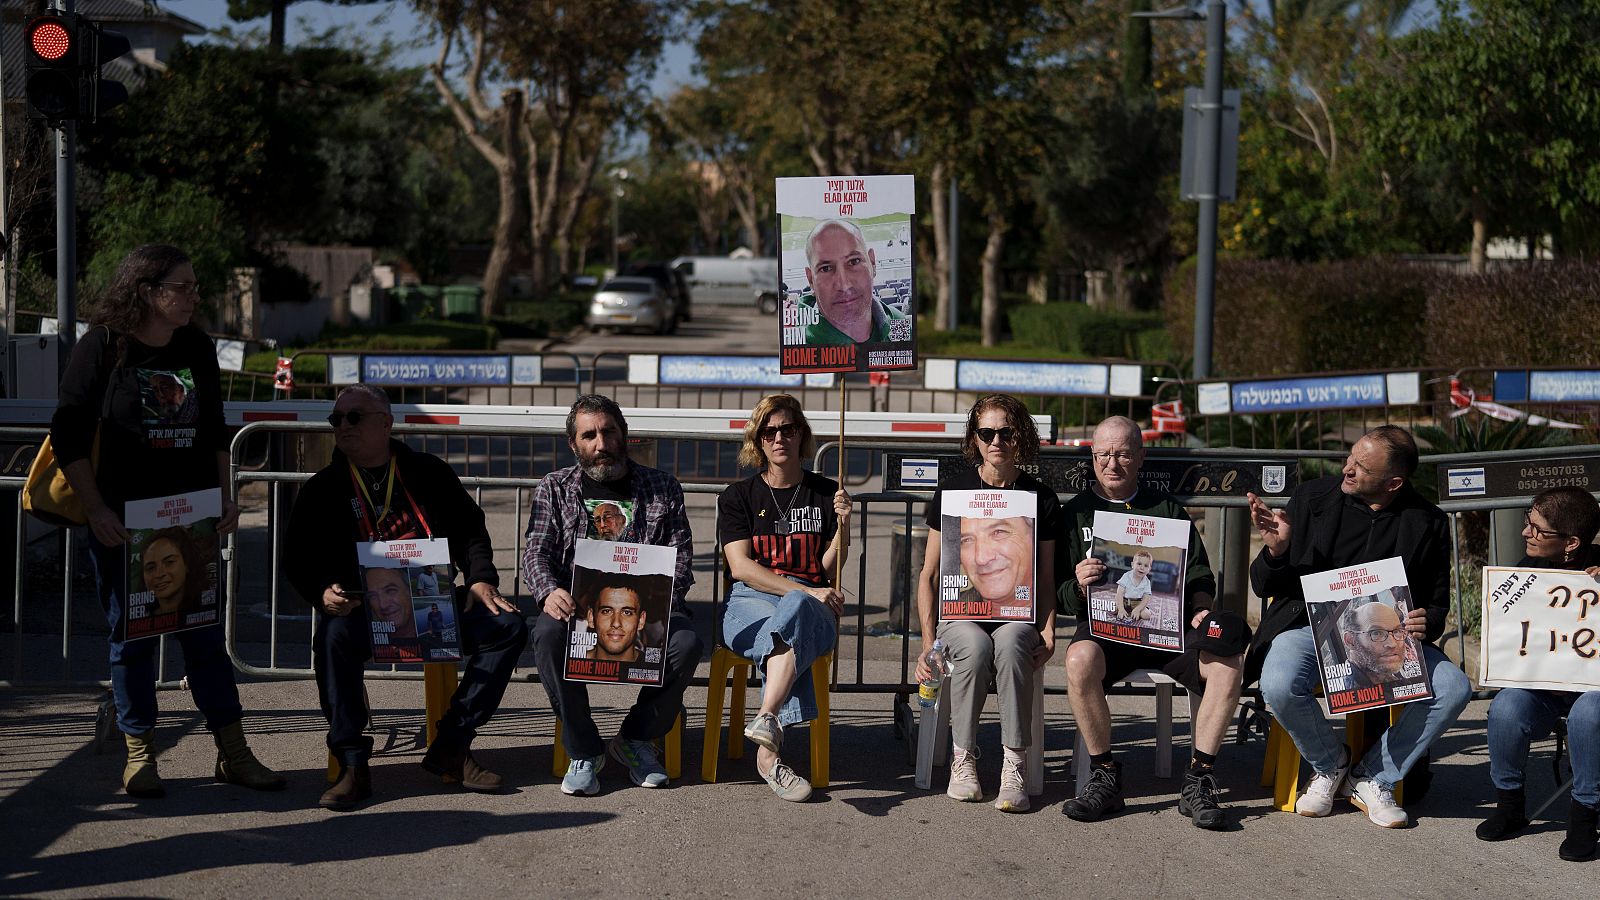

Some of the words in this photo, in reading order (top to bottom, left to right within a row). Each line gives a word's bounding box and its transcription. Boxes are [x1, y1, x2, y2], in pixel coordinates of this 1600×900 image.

[827, 180, 844, 191] קציר
[846, 180, 864, 191] אלעד
[824, 193, 842, 203] ELAD
[843, 192, 868, 203] KATZIR
[839, 204, 853, 216] (47)
[783, 307, 819, 326] BRING
[783, 327, 807, 345] HIM
[783, 347, 818, 366] HOME
[821, 344, 856, 365] NOW!
[869, 357, 893, 366] FAMILIES
[894, 357, 913, 365] FORUM
[370, 361, 429, 379] הממשלה
[434, 363, 464, 378] ראש
[470, 362, 507, 379] משרד
[1240, 388, 1302, 405] הממשלה
[1307, 385, 1338, 402] ראש
[1343, 383, 1382, 399] משרד
[1520, 465, 1585, 478] 04-8507033
[1126, 526, 1140, 535] ARIEL
[1140, 528, 1155, 537] BIBAS
[943, 575, 968, 588] BRING
[129, 591, 155, 606] BRING
[943, 588, 958, 600] HIM
[129, 605, 145, 620] HER
[942, 601, 967, 615] HOME
[967, 600, 992, 615] NOW!
[1091, 599, 1116, 612] BRING
[1091, 610, 1107, 622] HIM
[128, 618, 153, 633] HOME
[371, 621, 396, 633] BRING
[1092, 620, 1115, 634] HOME
[1117, 624, 1141, 639] NOW!
[373, 633, 389, 645] HIM
[571, 631, 598, 646] BRING
[1550, 628, 1600, 658] שיו
[570, 645, 587, 658] HIM
[568, 660, 593, 674] HOME
[595, 662, 620, 675] NOW!
[1324, 661, 1352, 679] BRING
[1327, 677, 1346, 693] HIM
[1330, 691, 1357, 708] HOME
[1357, 684, 1385, 702] NOW!
